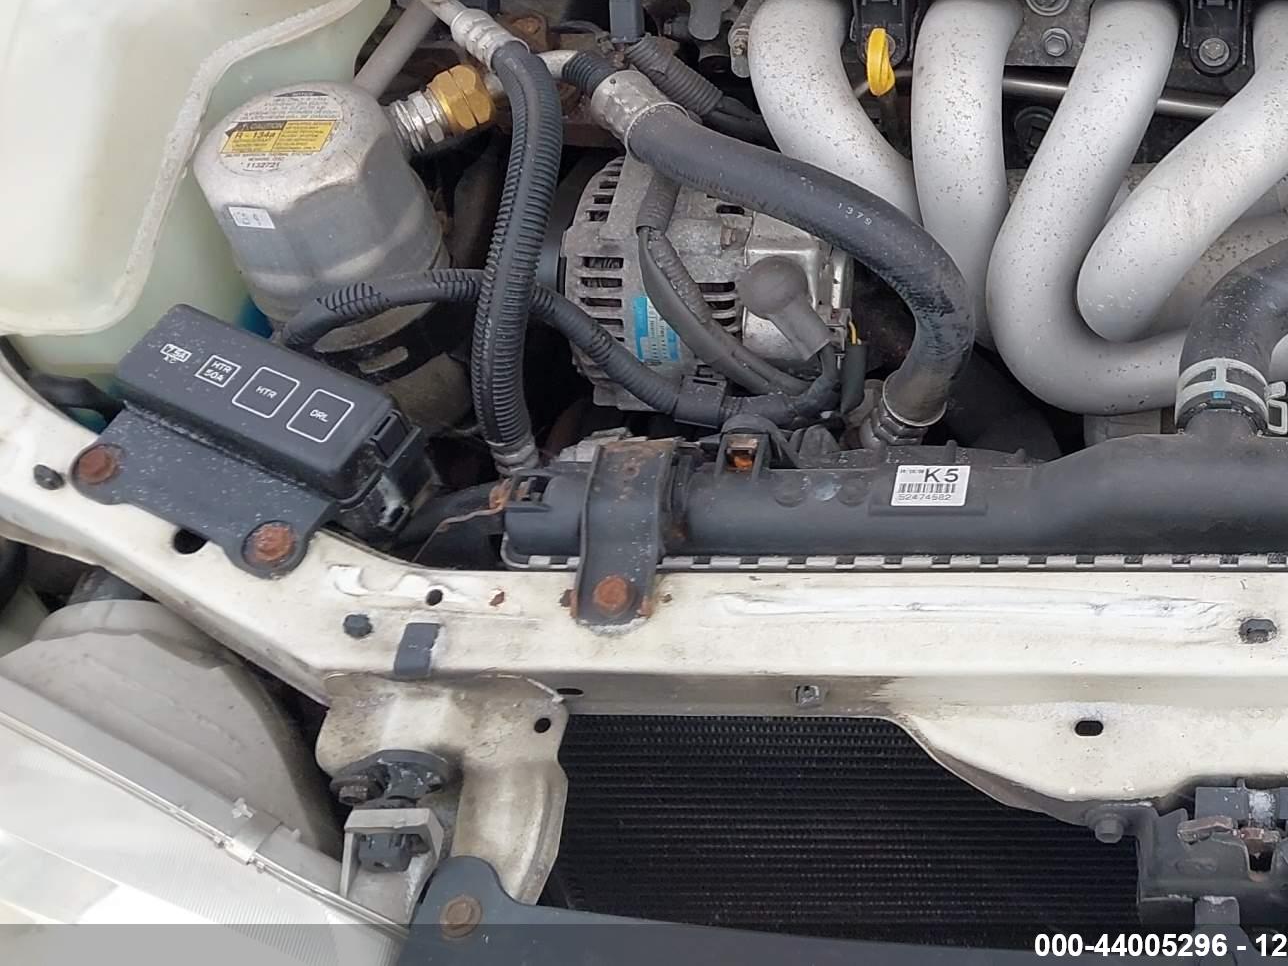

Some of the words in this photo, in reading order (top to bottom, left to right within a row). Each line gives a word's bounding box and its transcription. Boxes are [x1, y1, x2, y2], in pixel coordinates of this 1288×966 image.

[210, 360, 233, 374] HTR
[203, 368, 224, 382] 50A
[255, 385, 278, 399] HTR
[308, 408, 330, 423] DRL
[924, 467, 959, 483] K5
